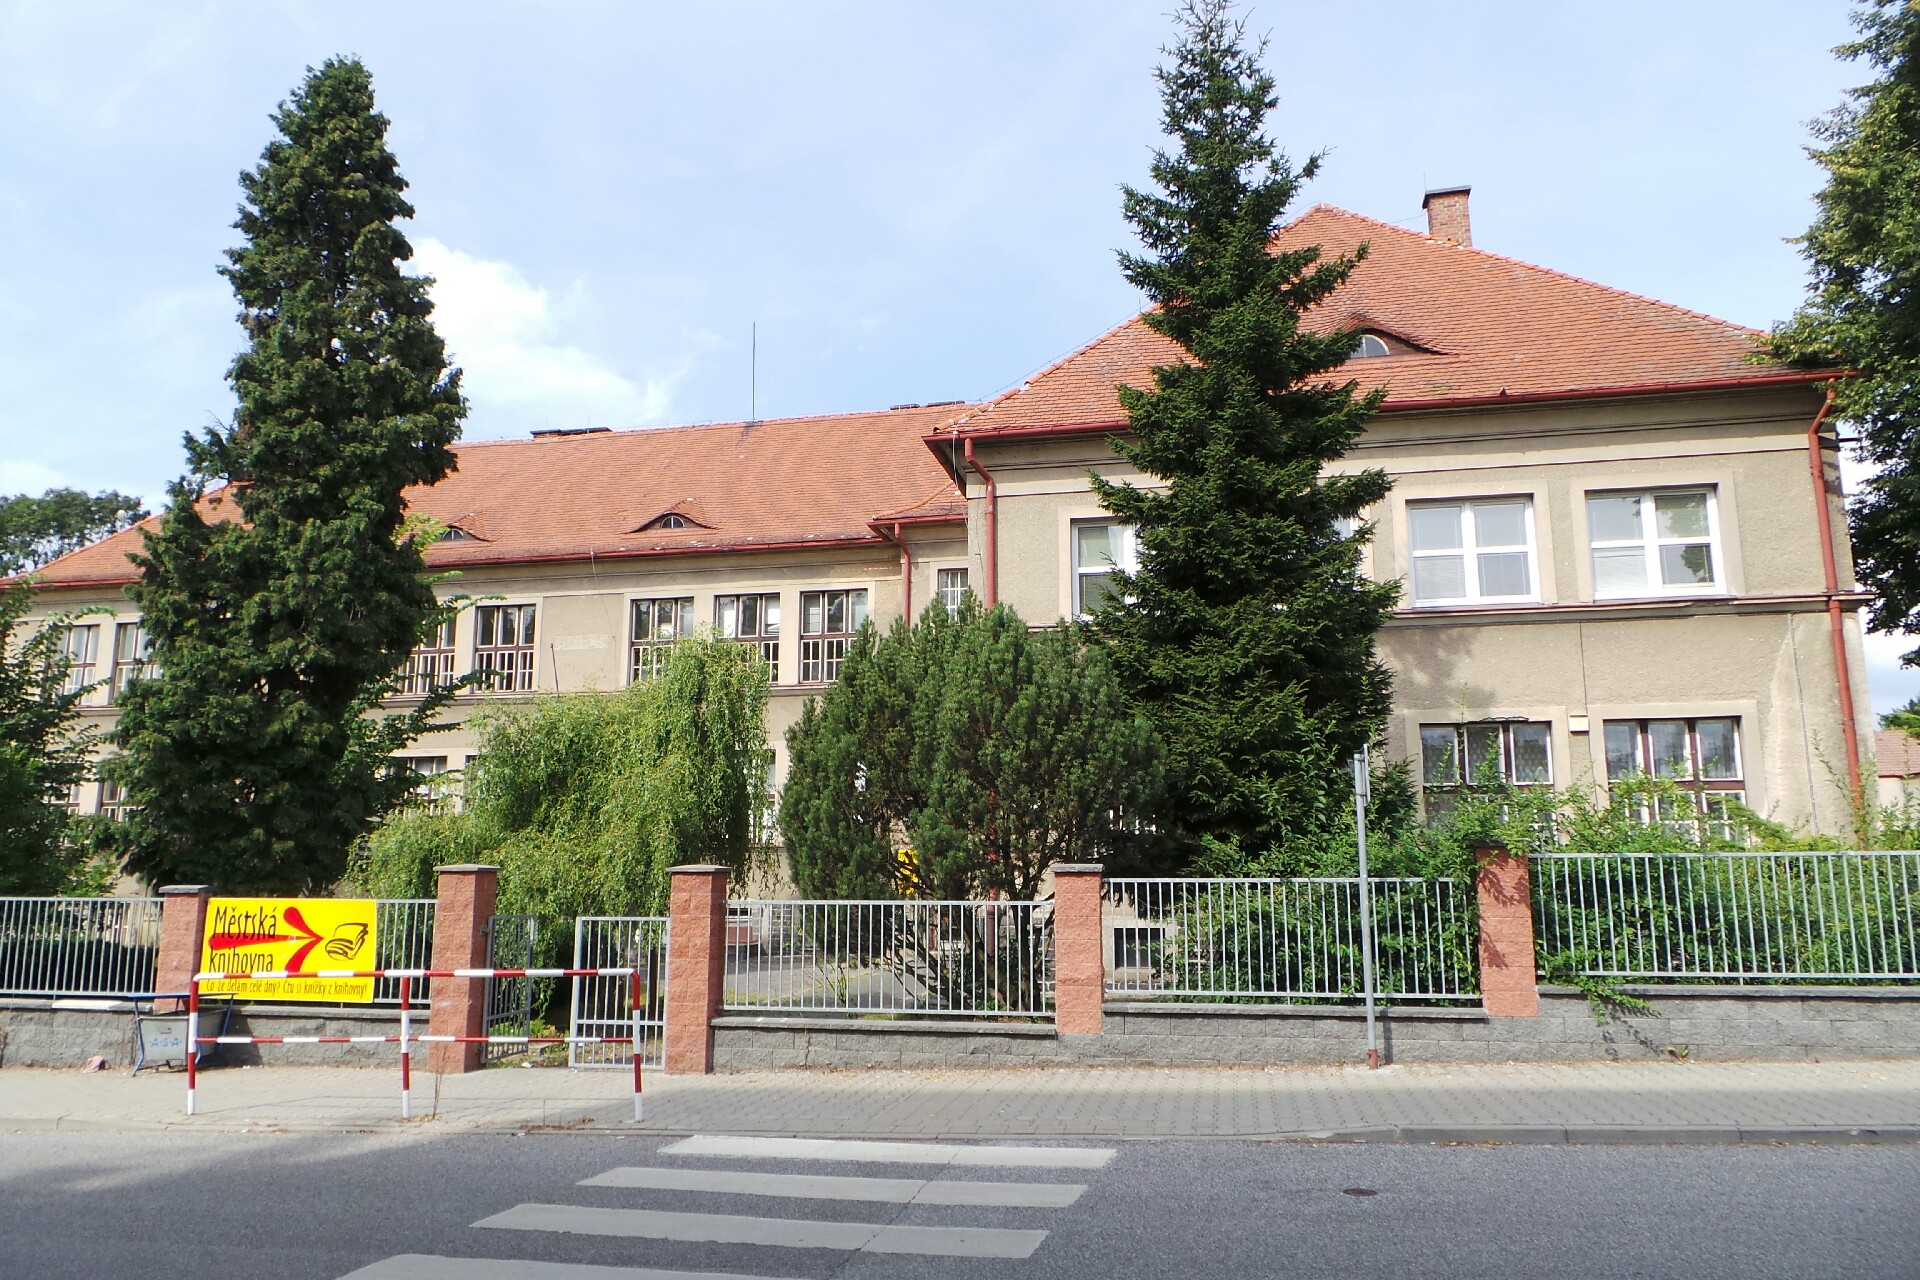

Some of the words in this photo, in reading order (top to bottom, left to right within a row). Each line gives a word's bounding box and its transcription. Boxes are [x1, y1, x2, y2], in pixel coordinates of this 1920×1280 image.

[213, 906, 277, 941] Městská
[208, 945, 273, 974] knihovna
[264, 980, 281, 997] dny?
[328, 983, 333, 995] z
